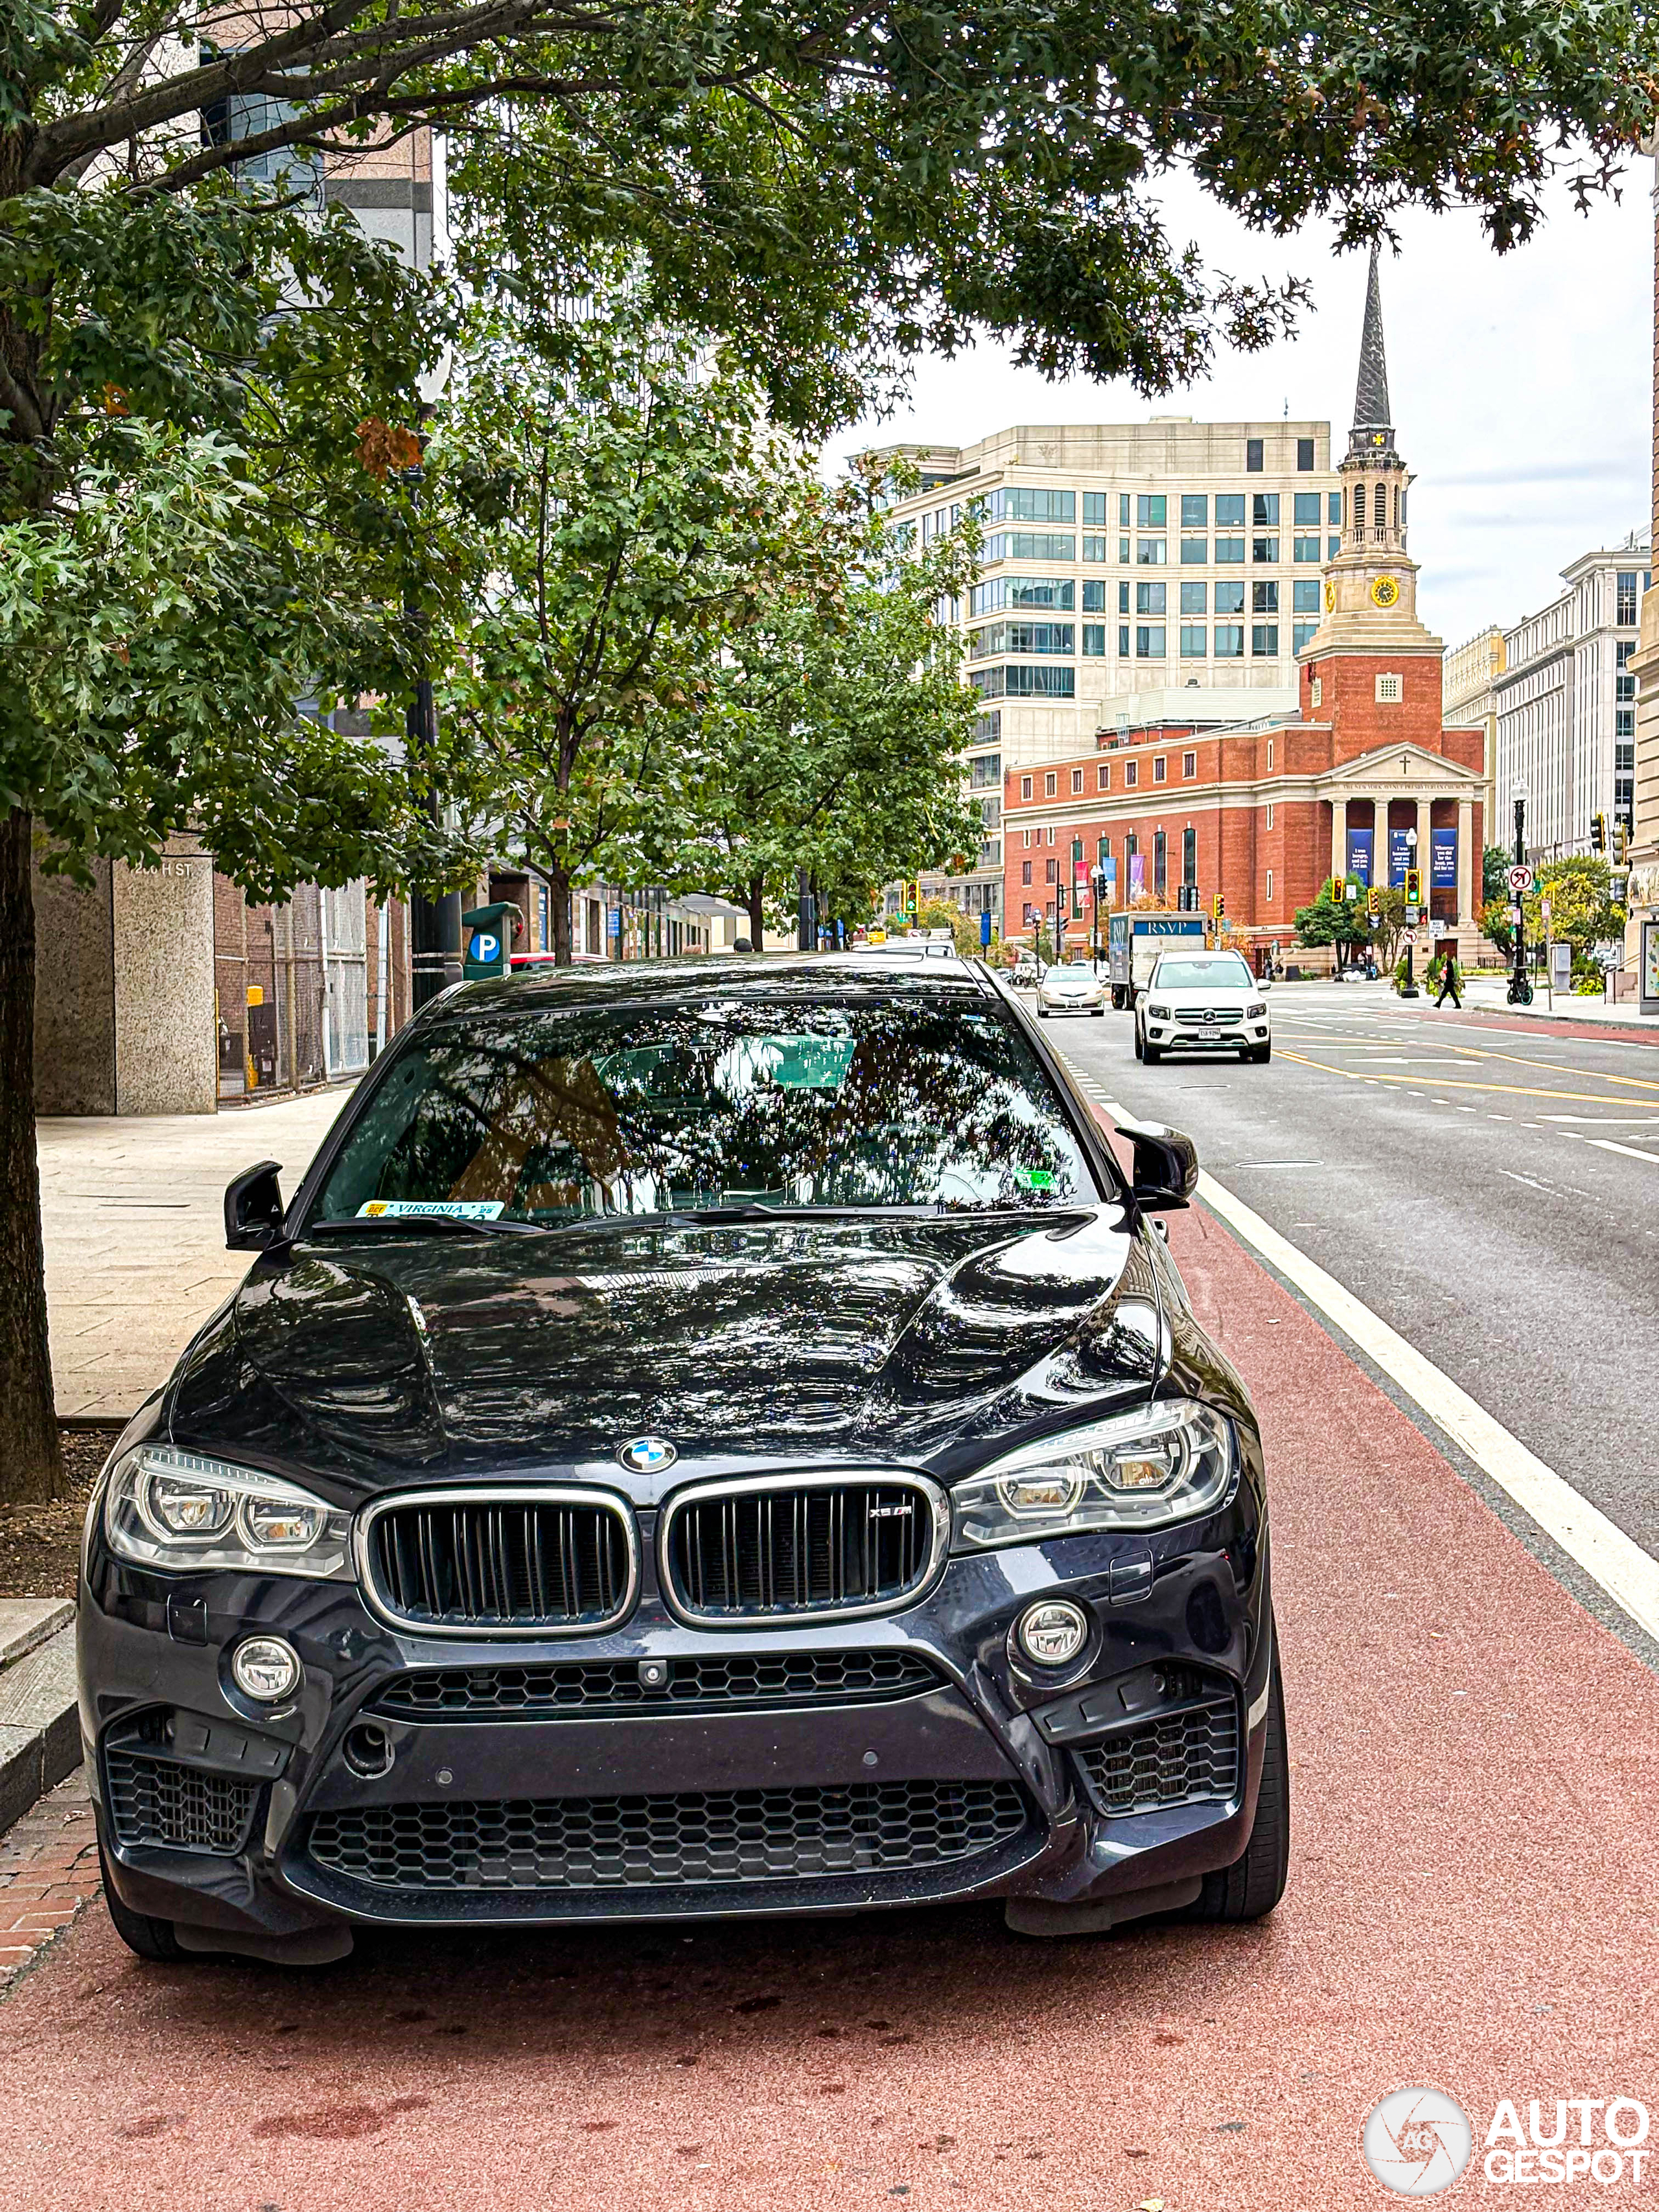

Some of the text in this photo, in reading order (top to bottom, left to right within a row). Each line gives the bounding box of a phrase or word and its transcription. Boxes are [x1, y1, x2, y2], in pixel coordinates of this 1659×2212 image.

[162, 863, 171, 876] H
[1148, 922, 1187, 935] RSVP
[479, 935, 496, 960] P
[398, 1204, 463, 1213] VIRGINIA
